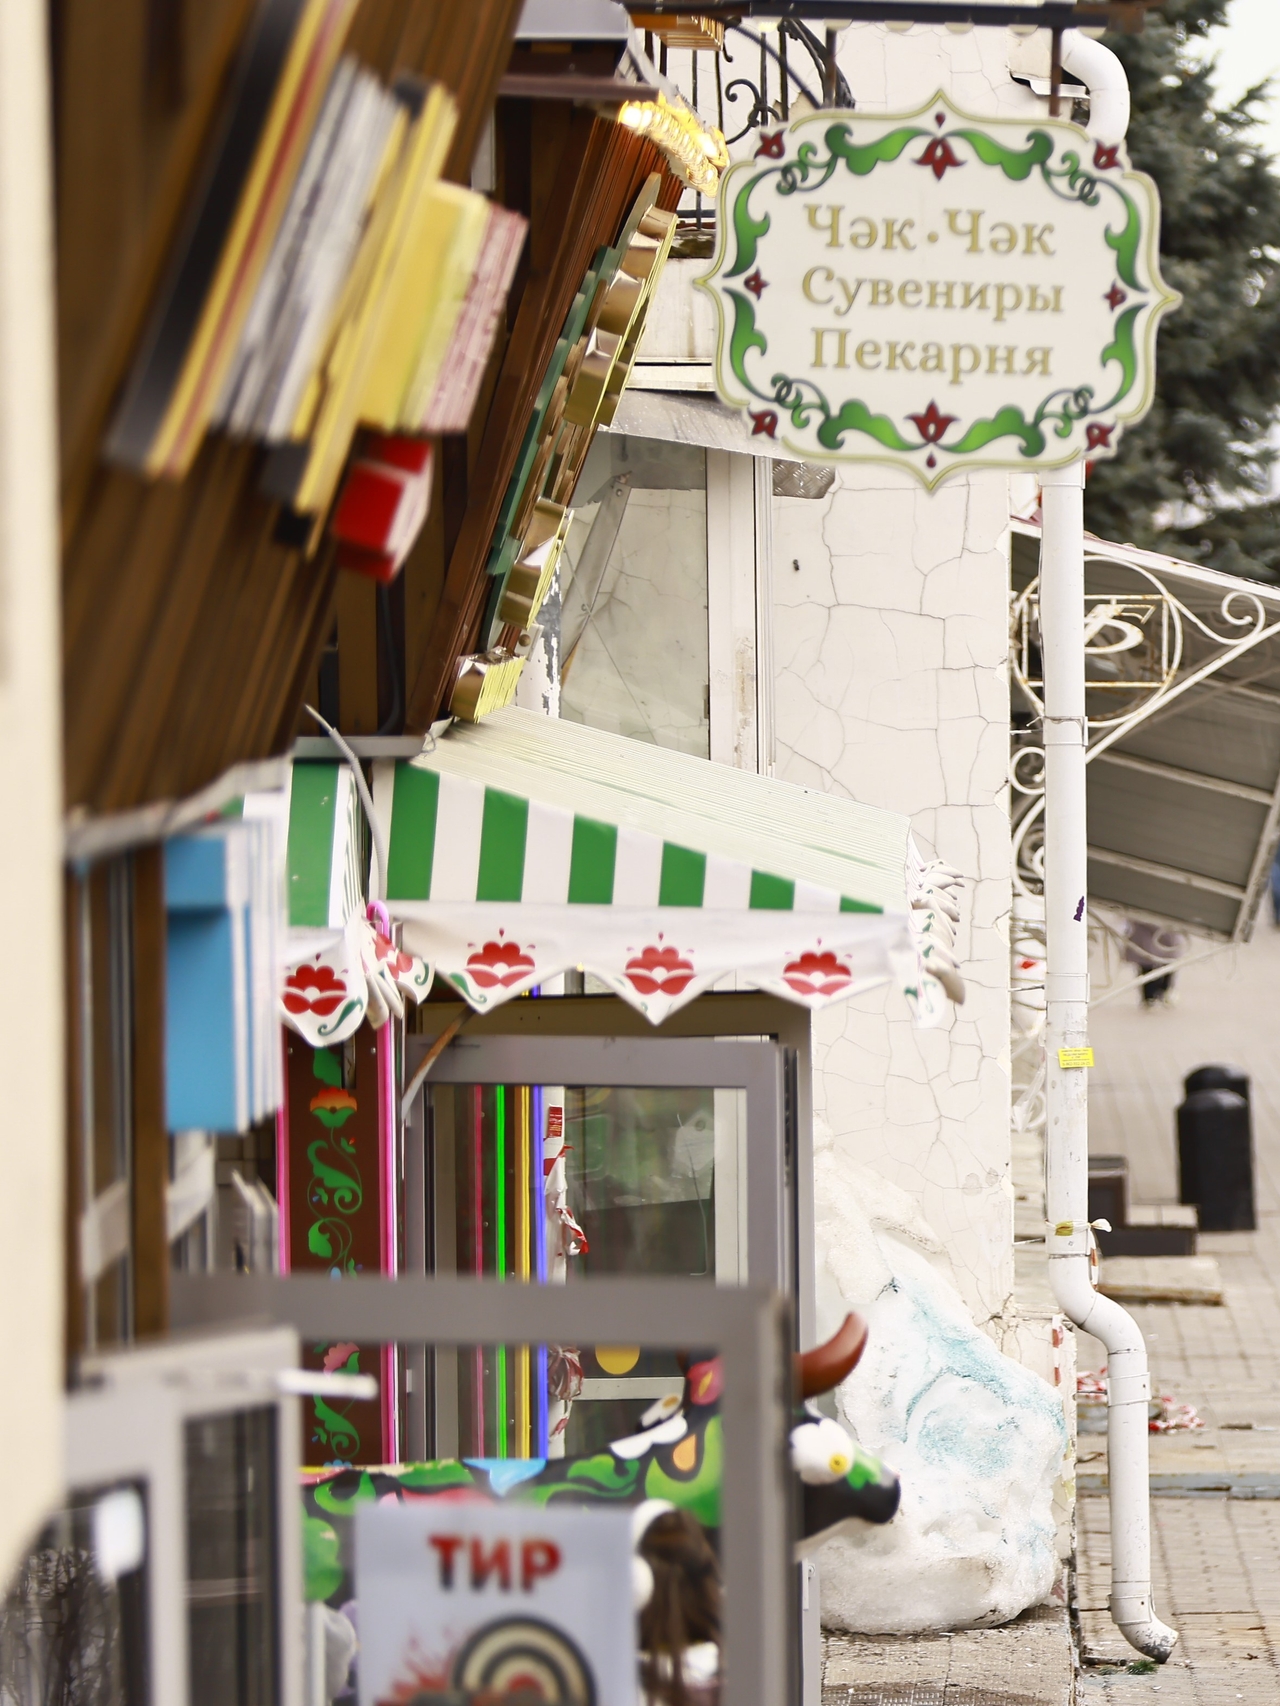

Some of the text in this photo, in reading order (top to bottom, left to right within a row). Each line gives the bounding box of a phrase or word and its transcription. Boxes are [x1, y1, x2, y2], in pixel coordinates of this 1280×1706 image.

[801, 266, 1064, 322] Сувениры
[809, 327, 1053, 385] Пекарня
[428, 1533, 562, 1593] ТИР
